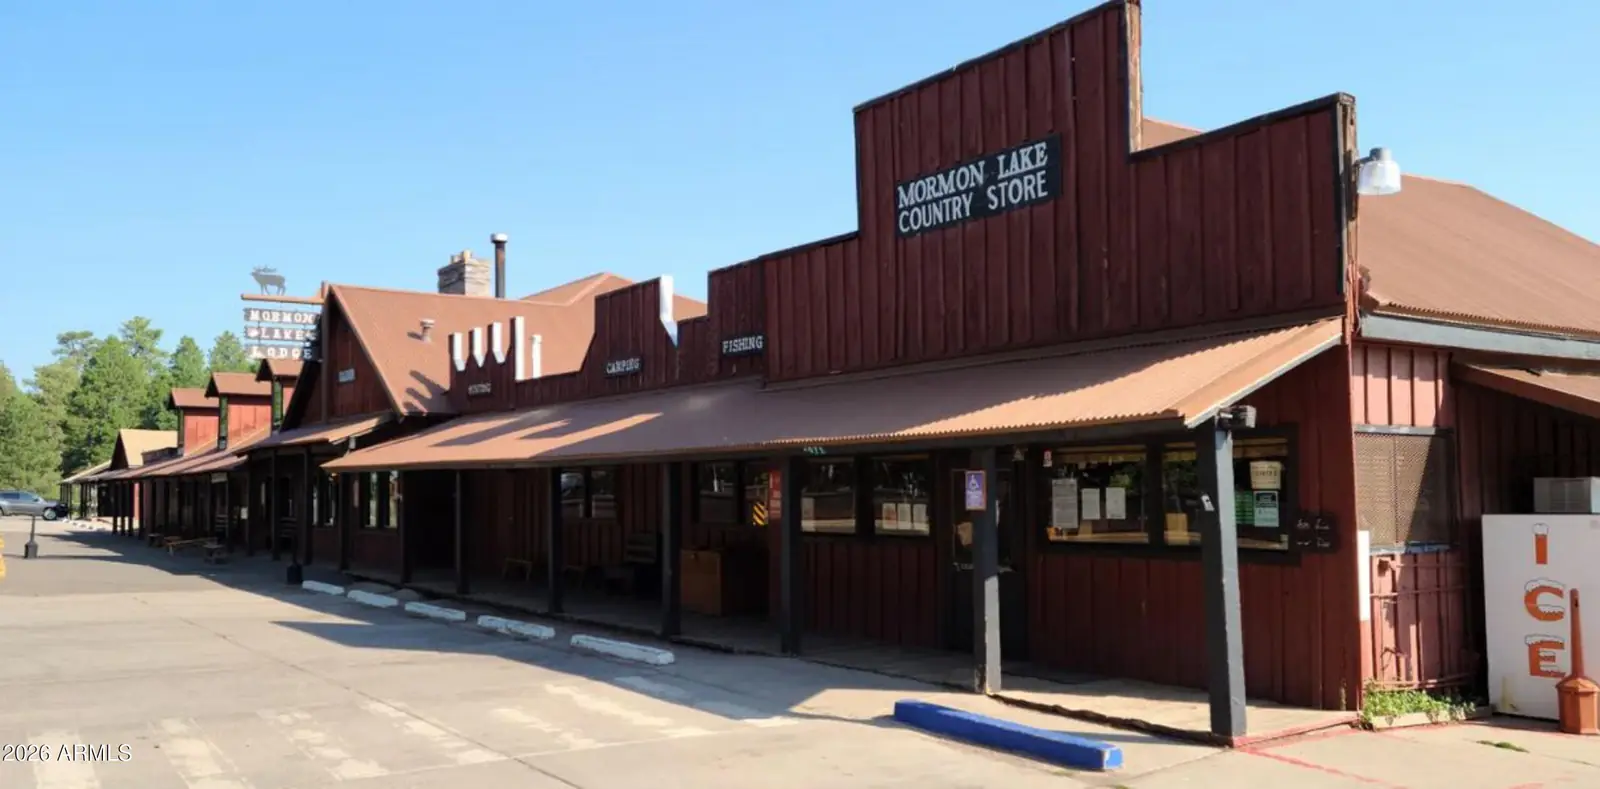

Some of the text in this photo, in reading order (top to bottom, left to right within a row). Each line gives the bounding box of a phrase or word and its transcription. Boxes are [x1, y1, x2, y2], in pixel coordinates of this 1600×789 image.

[898, 141, 1049, 209] MORMON LAKE
[899, 170, 1049, 233] COUNTRY STORE
[250, 308, 315, 324] MORMON
[261, 327, 305, 340] LAKE
[249, 345, 313, 360] LODGE
[722, 335, 763, 354] FISHING
[1523, 523, 1567, 678] ICE
